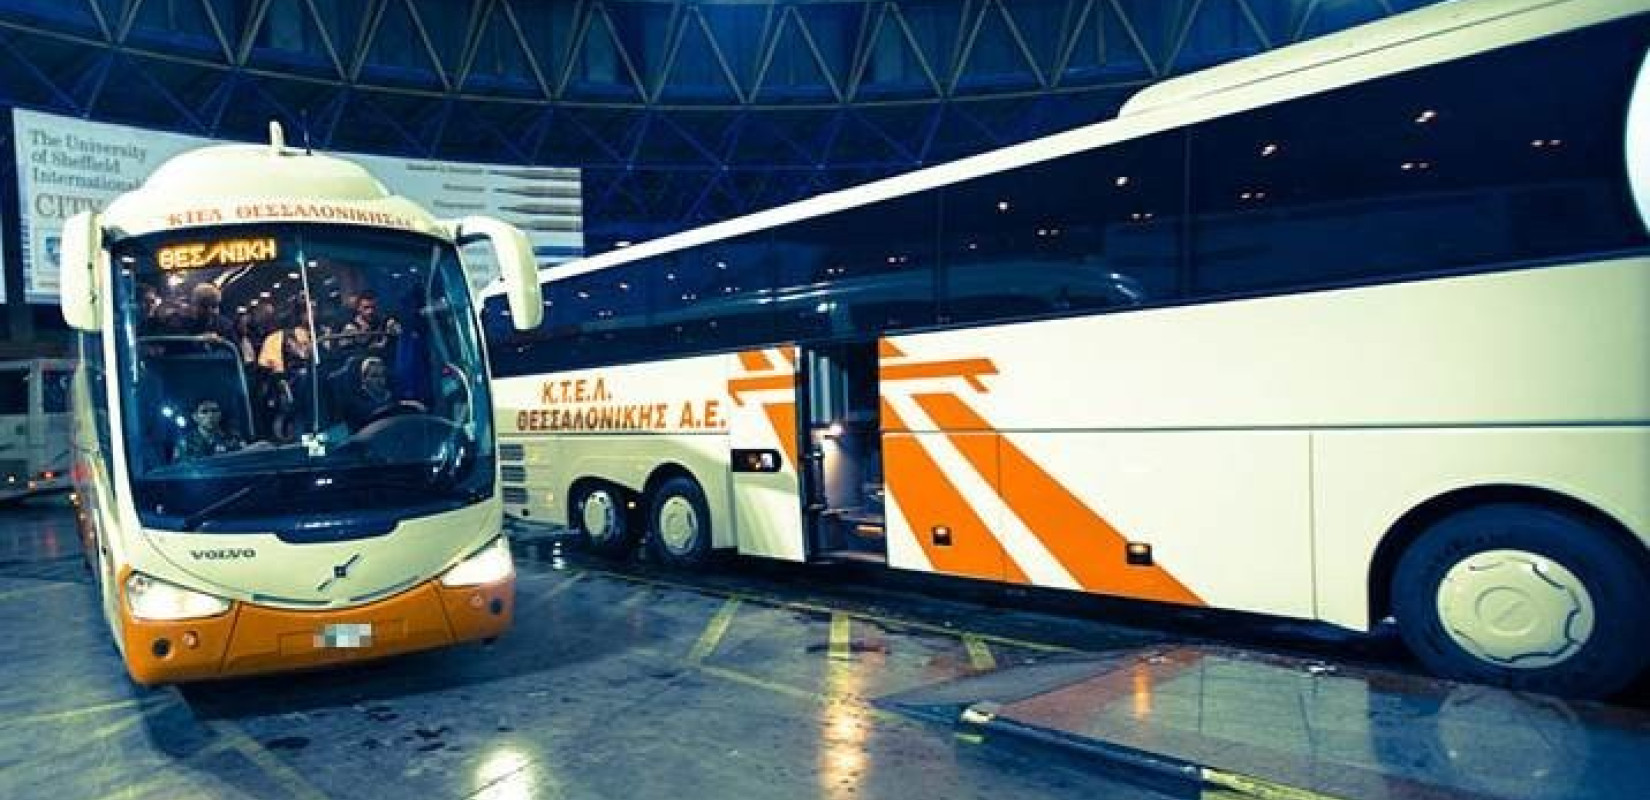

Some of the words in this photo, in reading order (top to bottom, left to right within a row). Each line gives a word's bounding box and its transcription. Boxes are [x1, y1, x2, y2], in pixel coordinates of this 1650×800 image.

[30, 129, 62, 145] The
[64, 132, 146, 163] University
[32, 148, 48, 163] of
[52, 151, 120, 174] Sheffield
[235, 203, 394, 226] ΘΕΣΣΑΛΟΝΙΚΗΣ
[158, 238, 276, 268] ΘΕΣ/ΝΙΚΗ
[541, 377, 612, 403] Κ.Τ.Ε.Λ.
[517, 403, 667, 430] ΘΕΣΣΑΛΟΝΙΚΗΣ
[680, 400, 727, 428] Α.Ε.
[190, 548, 257, 560] VOLVO
